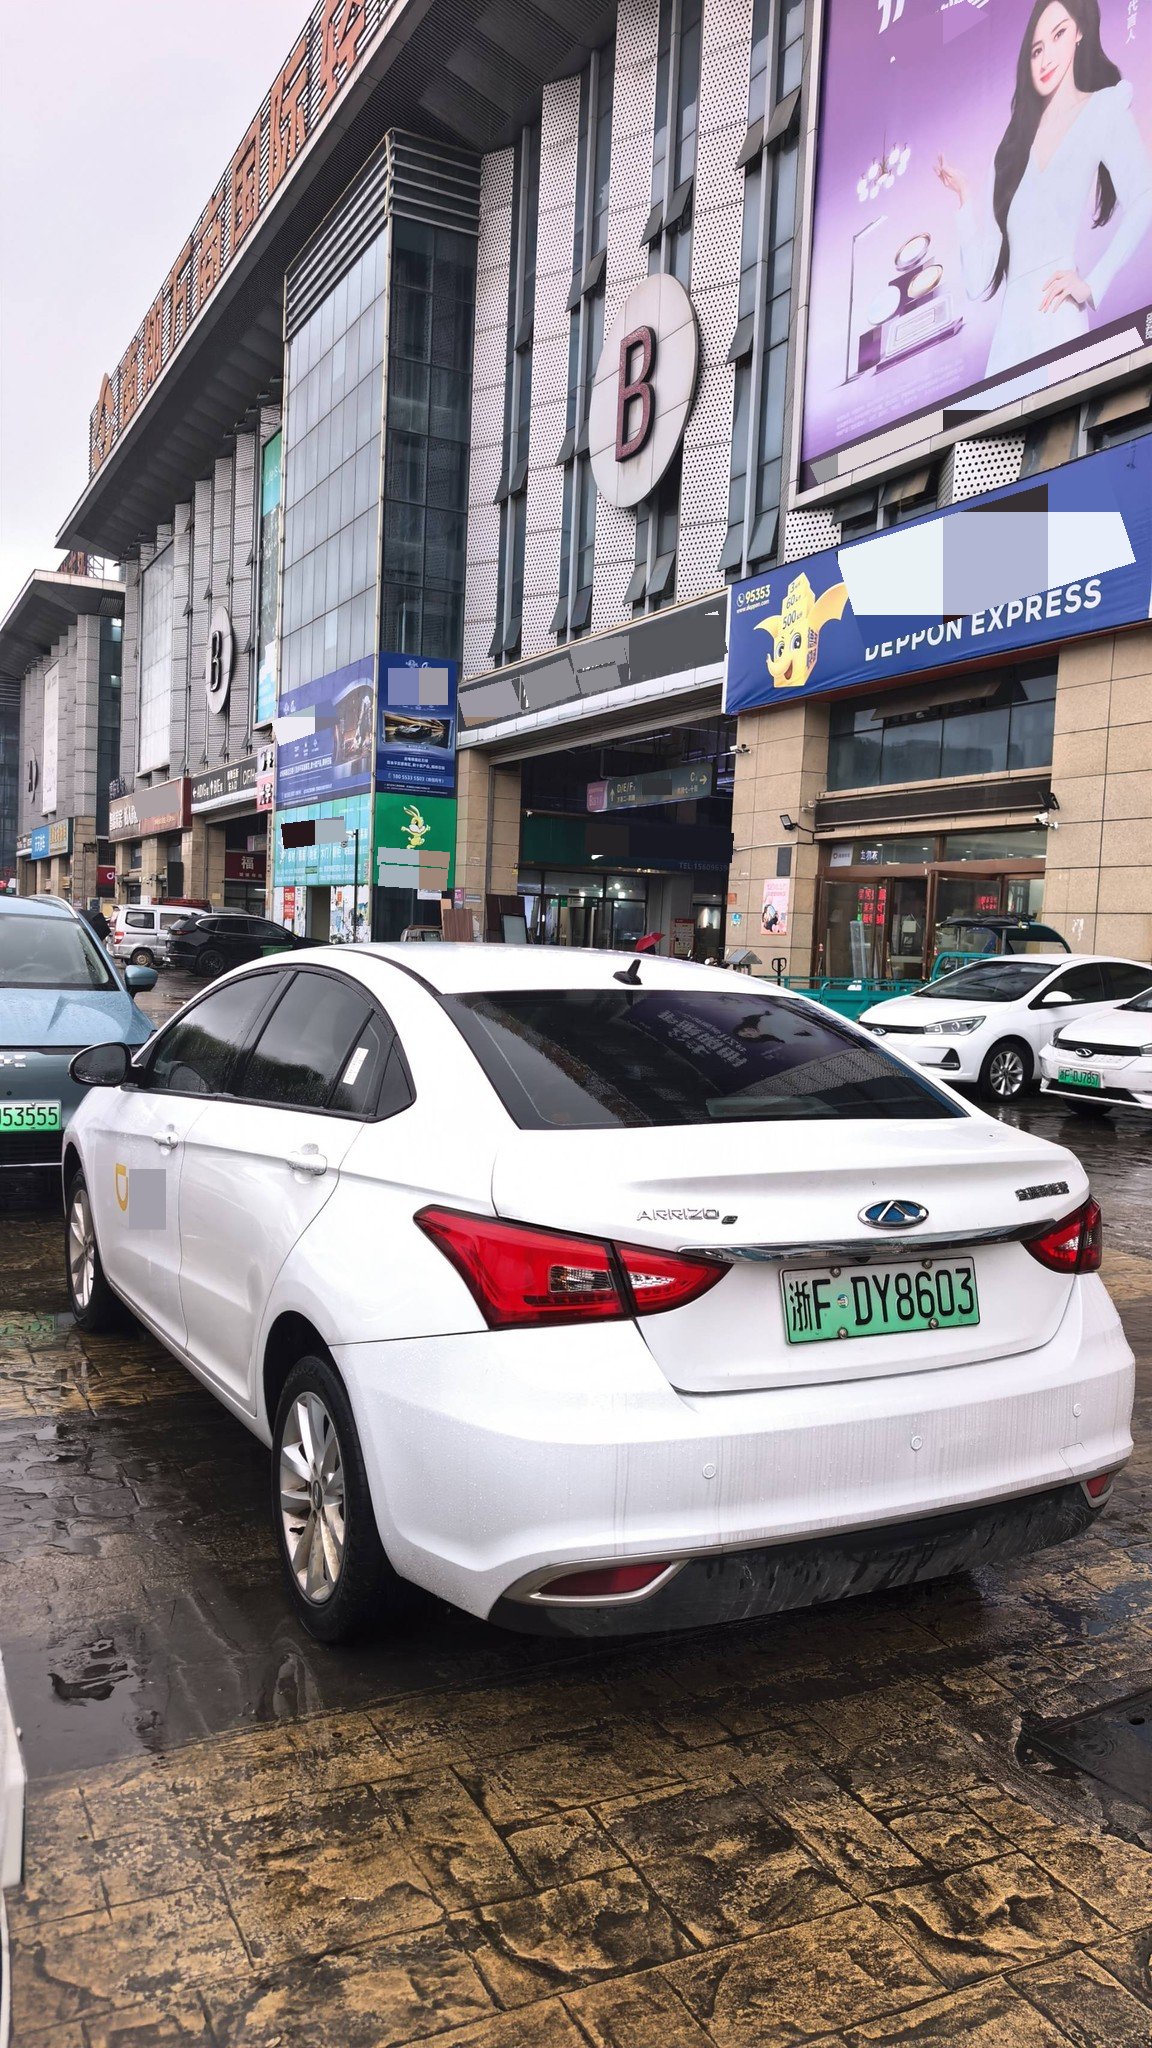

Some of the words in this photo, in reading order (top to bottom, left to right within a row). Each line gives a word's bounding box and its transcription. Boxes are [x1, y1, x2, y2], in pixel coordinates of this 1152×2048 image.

[615, 325, 657, 463] B
[745, 584, 771, 604] 95353
[970, 578, 1103, 636] EXPRESS
[210, 630, 223, 693] B
[241, 856, 254, 870] 福
[0, 1106, 58, 1127] 53555
[636, 1208, 720, 1222] ARRIZO
